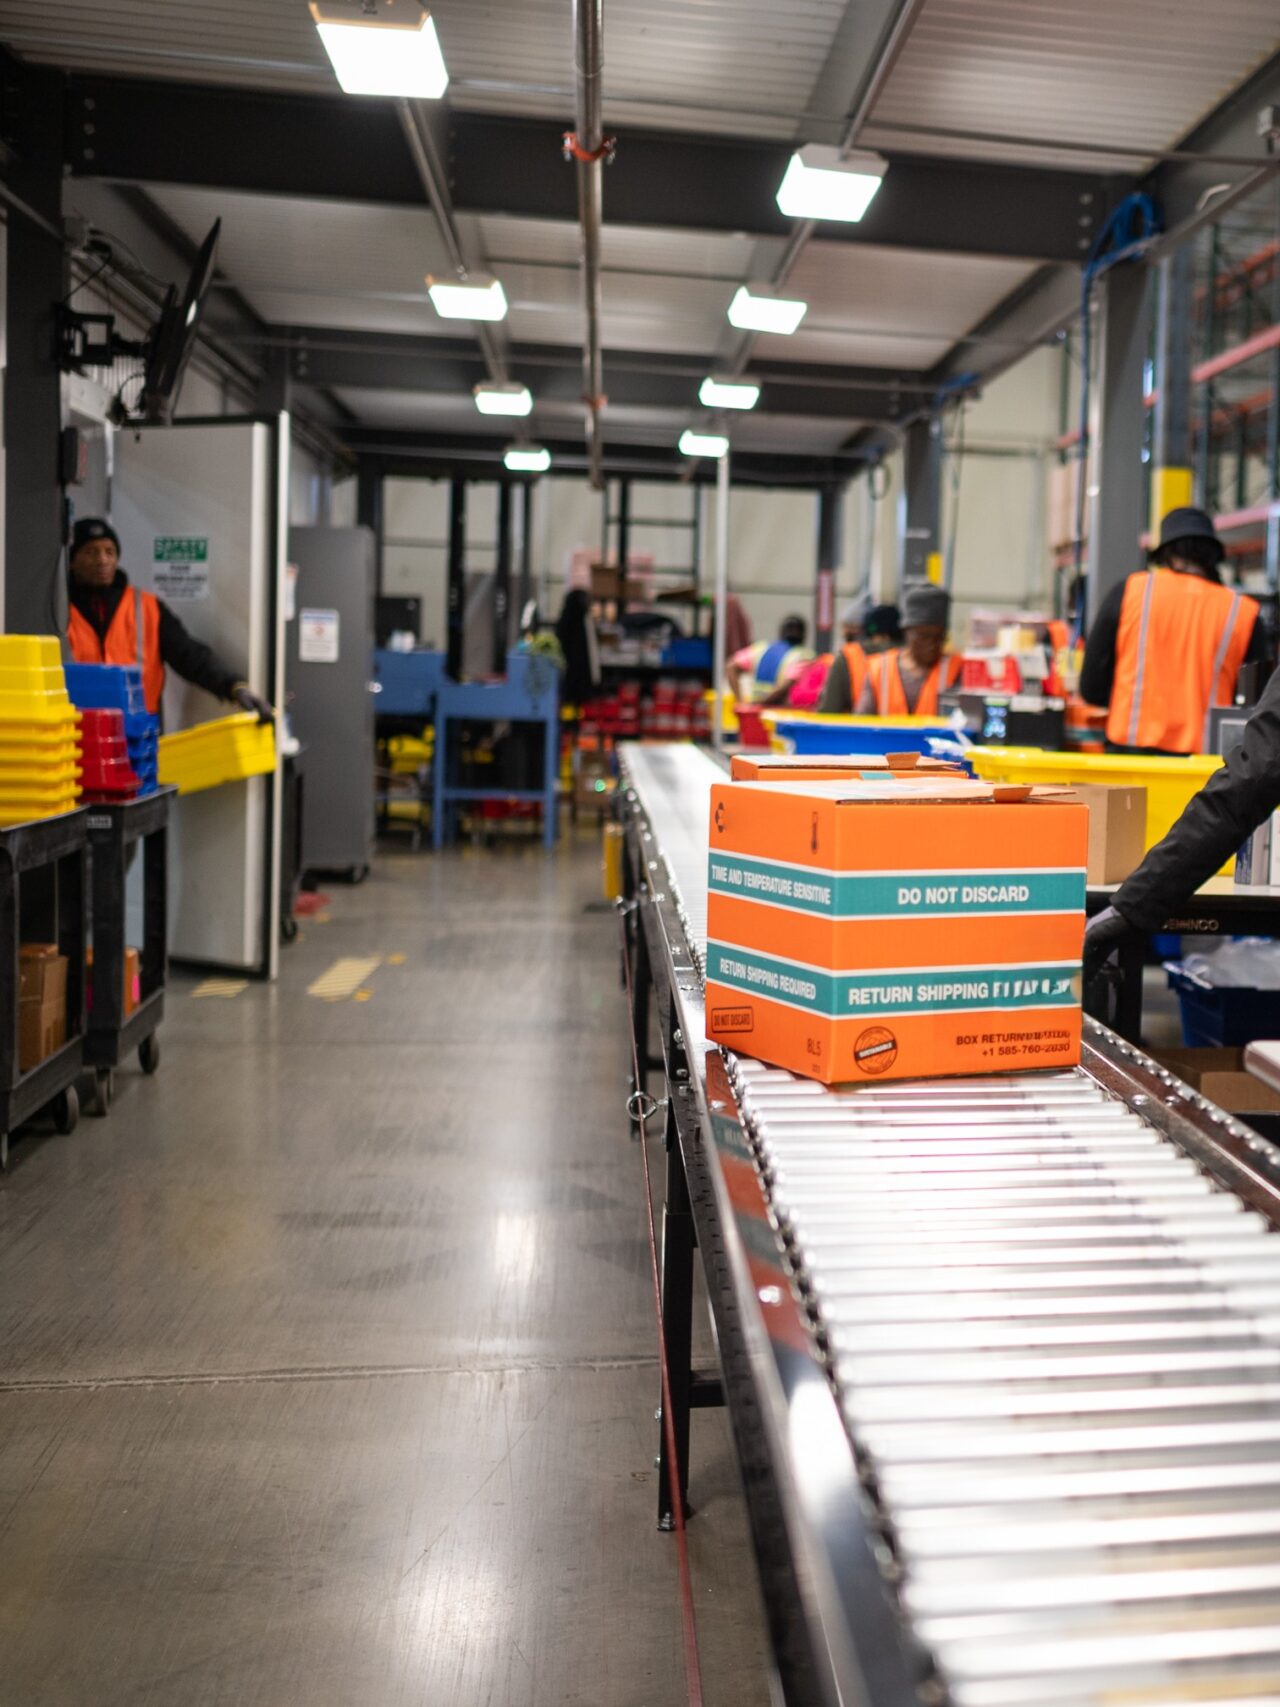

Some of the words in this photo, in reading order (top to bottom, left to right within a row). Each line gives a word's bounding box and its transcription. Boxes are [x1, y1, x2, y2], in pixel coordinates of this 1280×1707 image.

[711, 865, 727, 882] TIME
[728, 868, 742, 885] AND
[744, 871, 792, 896] TEMPERATURE
[793, 882, 831, 905] SENSITIVE
[898, 888, 921, 904] DO
[925, 887, 958, 904] NOT
[962, 886, 1029, 903] DISCARD
[720, 958, 746, 979] RETURN
[747, 966, 779, 989] SHIPPING
[779, 974, 816, 1000] REQUIRED
[849, 985, 913, 1006] RETURN
[917, 983, 988, 1002] SHIPPING
[956, 1035, 978, 1045] BOX
